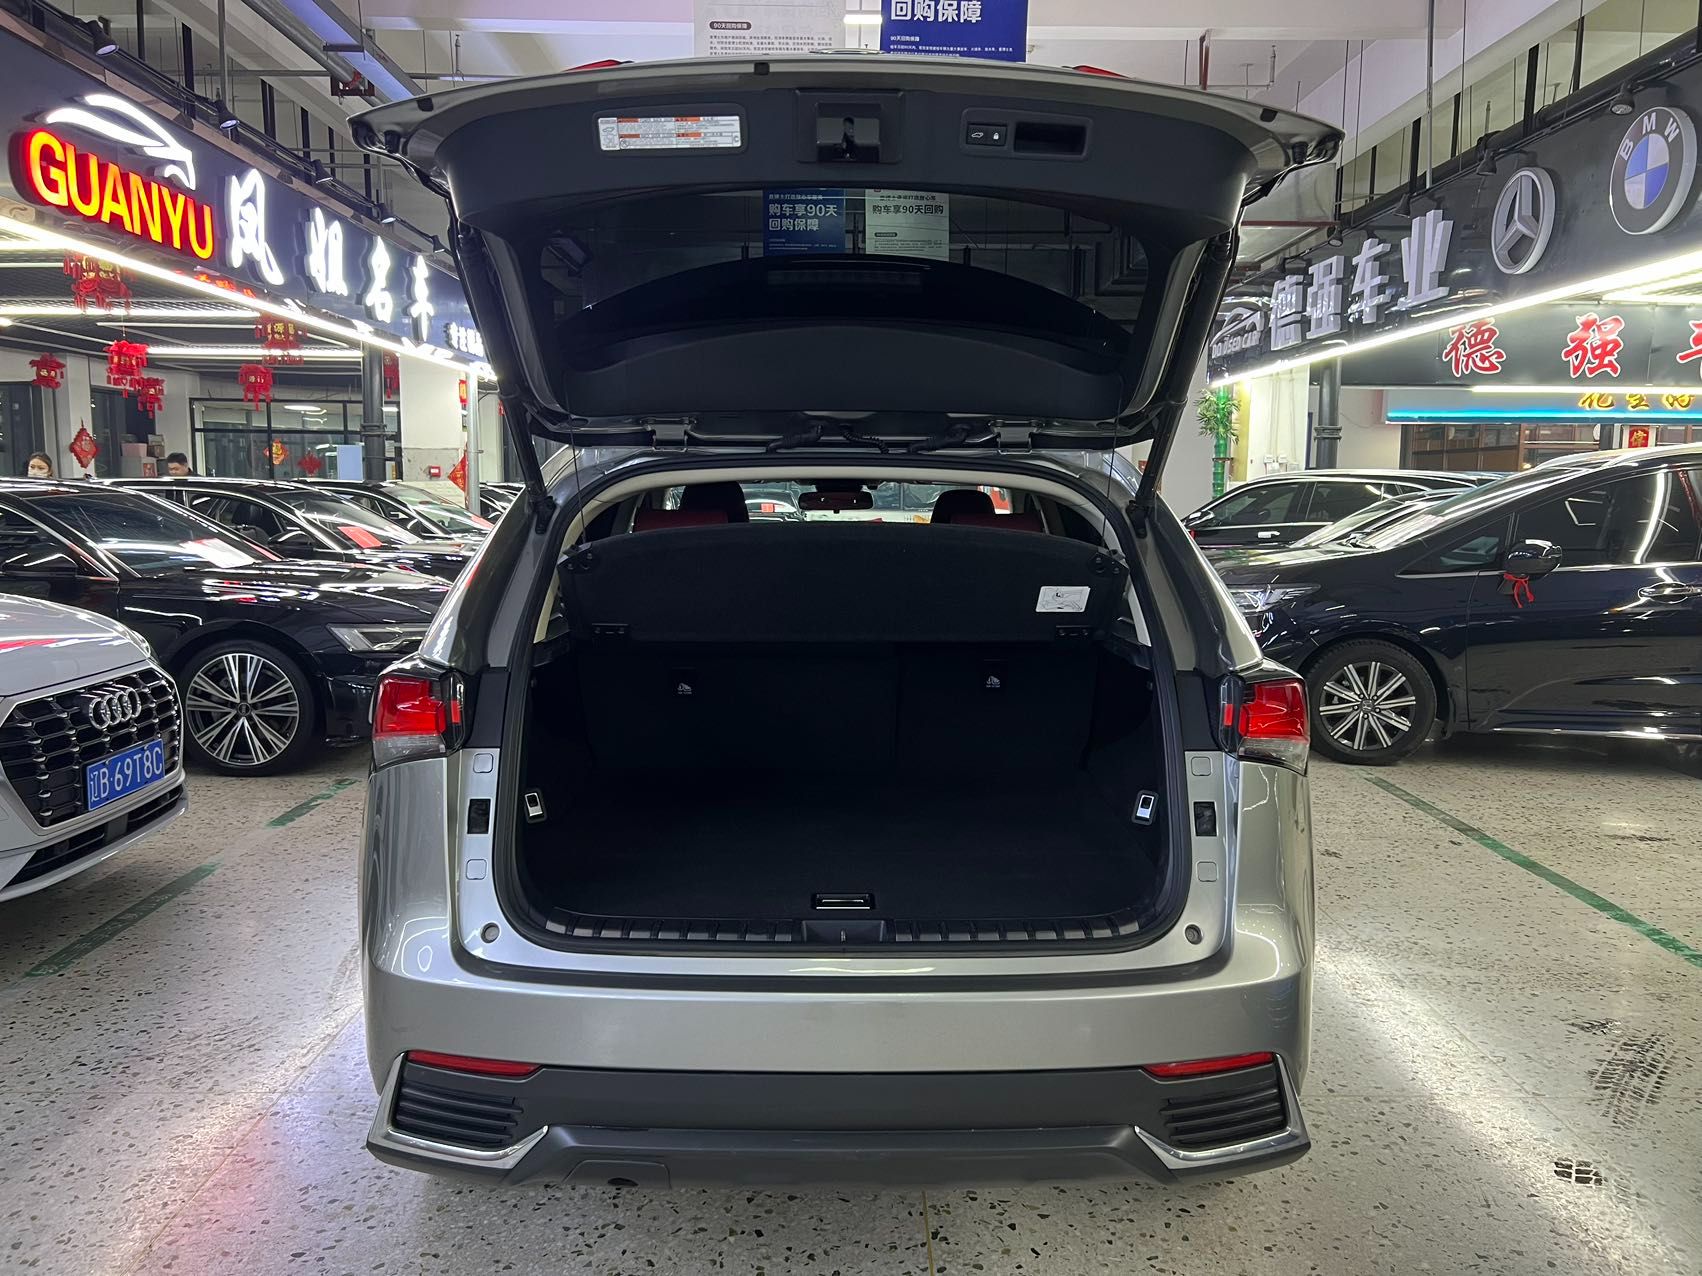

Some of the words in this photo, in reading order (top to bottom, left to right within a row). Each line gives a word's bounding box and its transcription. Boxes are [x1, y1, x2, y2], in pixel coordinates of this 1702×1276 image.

[890, 0, 982, 23] 回购保障
[1619, 111, 1680, 161] BMW
[25, 128, 216, 261] GUANYU
[768, 203, 838, 217] 购车享90天
[872, 204, 944, 215] 购车享90天回购
[768, 218, 820, 231] 回购保障
[1270, 209, 1454, 351] 德强车业
